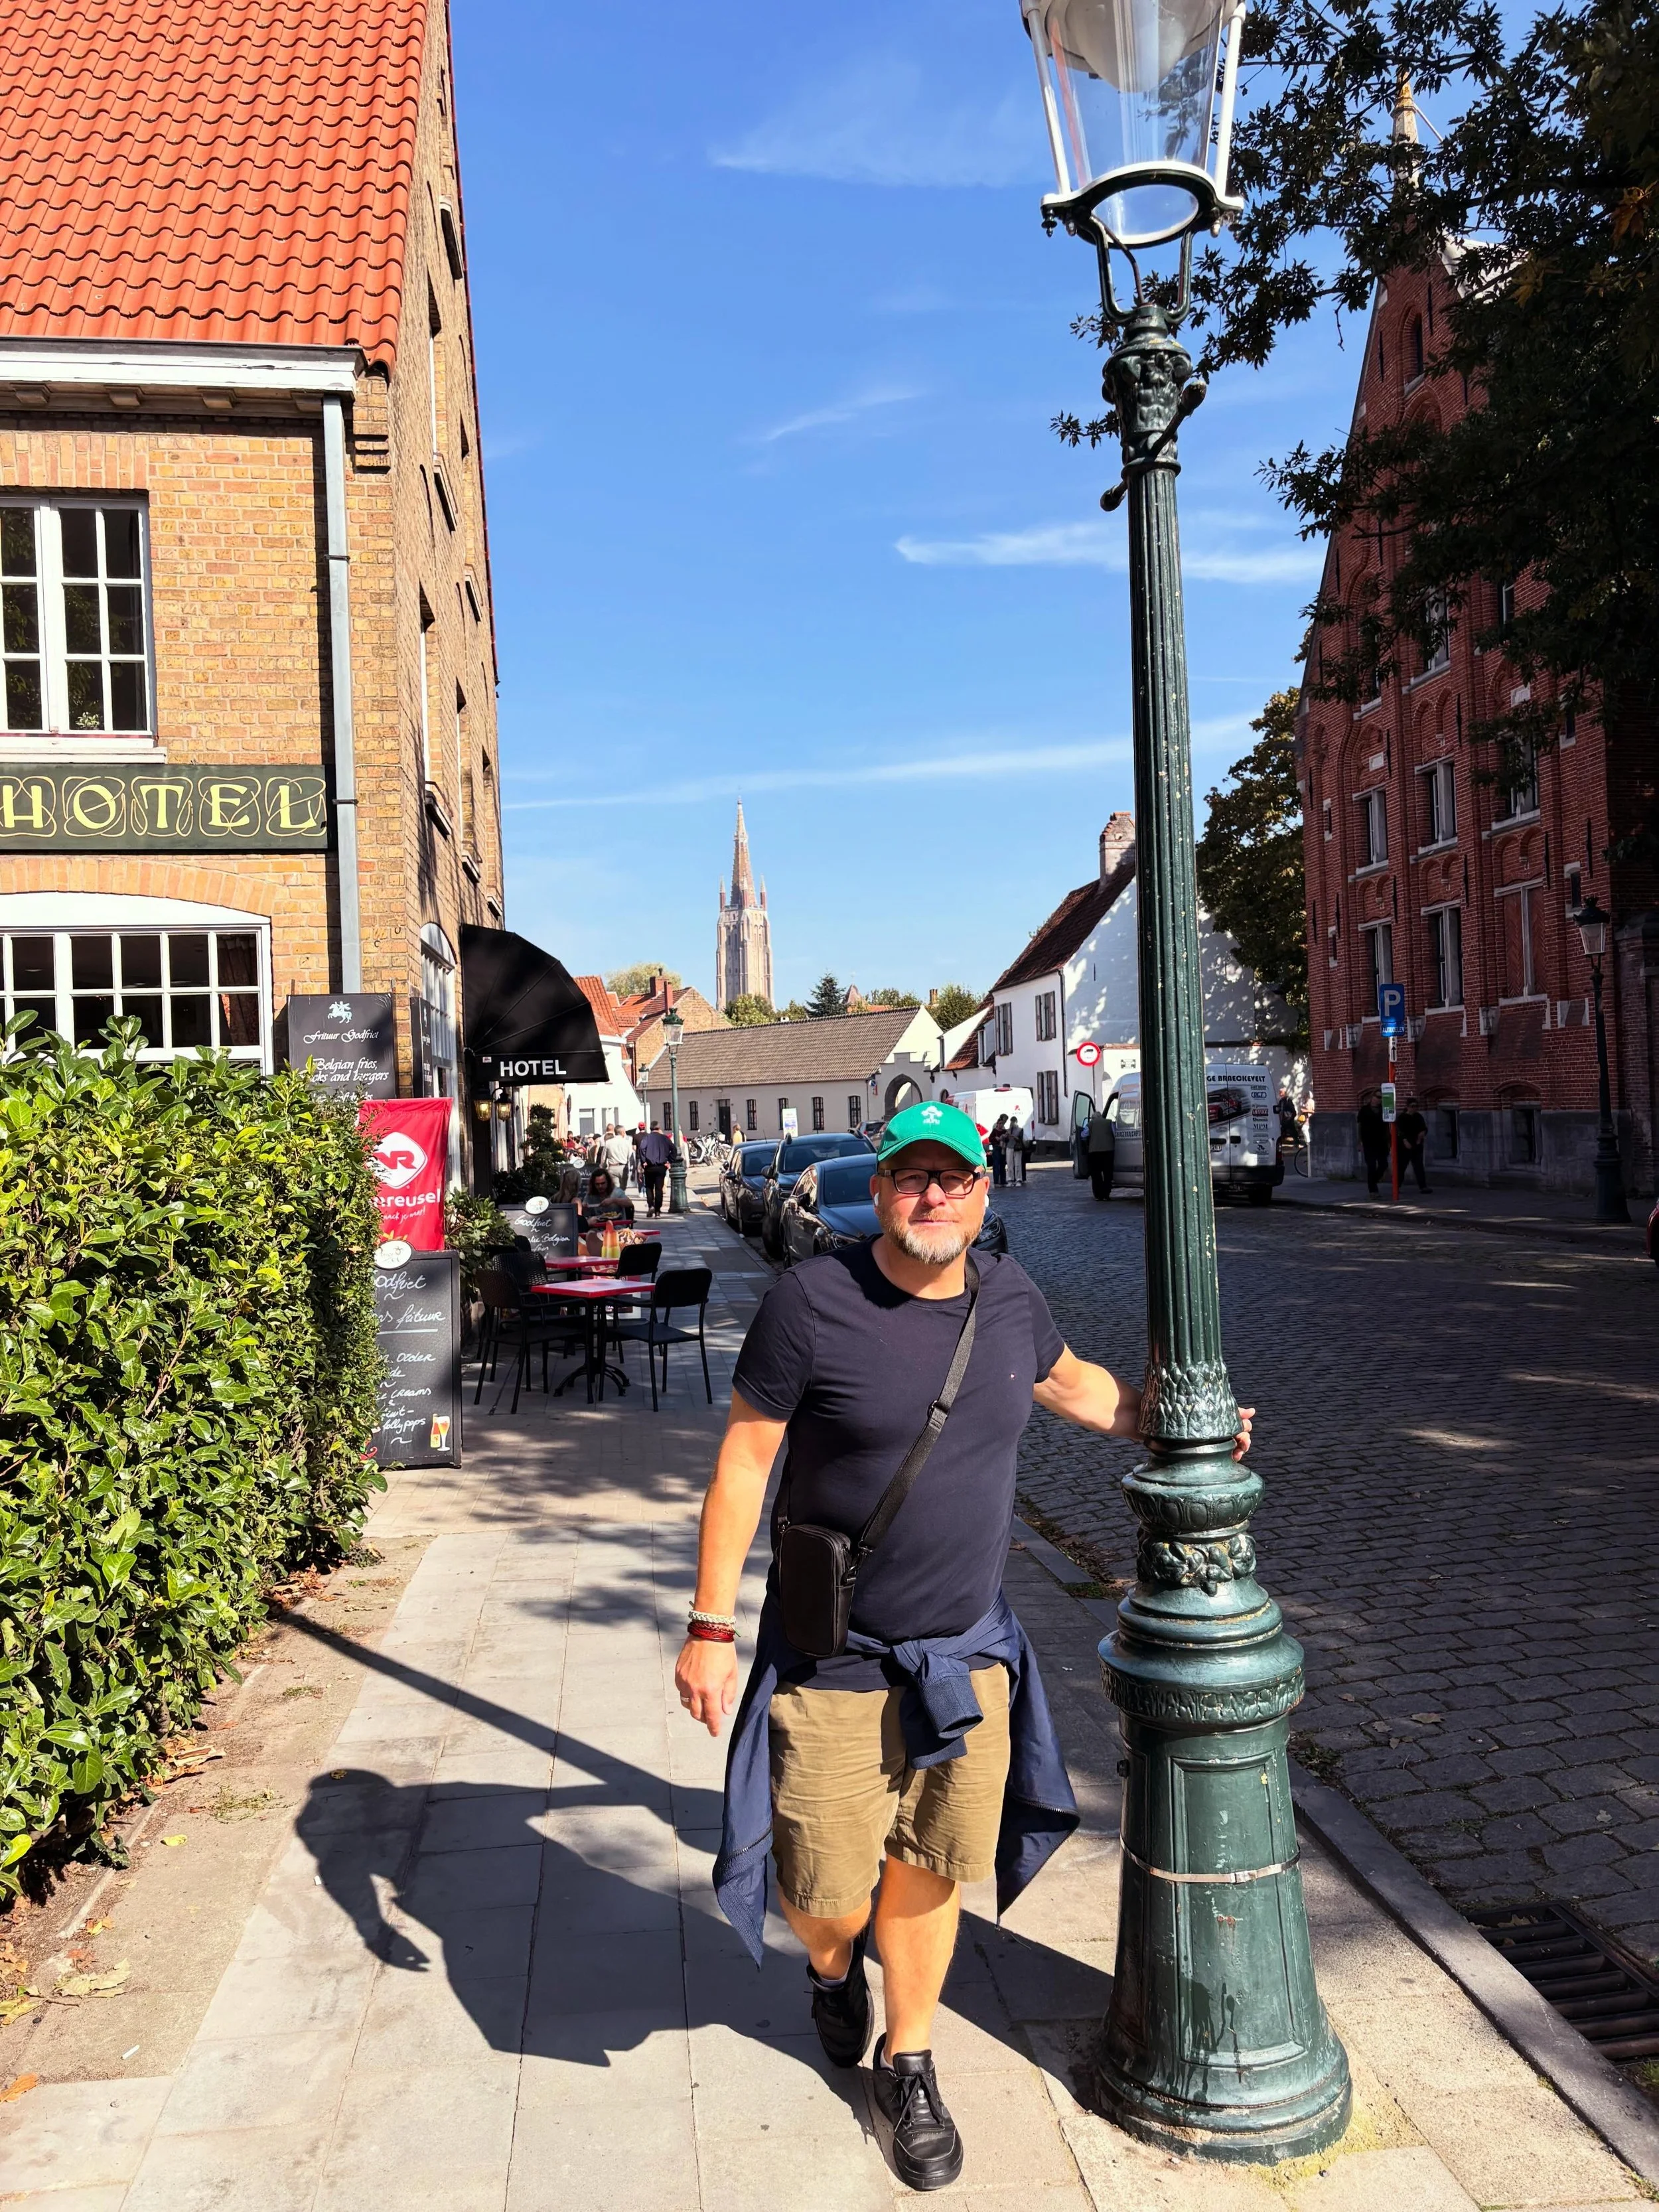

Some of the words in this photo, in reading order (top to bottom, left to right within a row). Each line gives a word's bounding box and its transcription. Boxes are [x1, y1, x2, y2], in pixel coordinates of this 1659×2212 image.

[2, 784, 317, 828] HOTEL
[1384, 990, 1401, 1017] P
[330, 1070, 352, 1082] and
[500, 1059, 567, 1076] HOTEL
